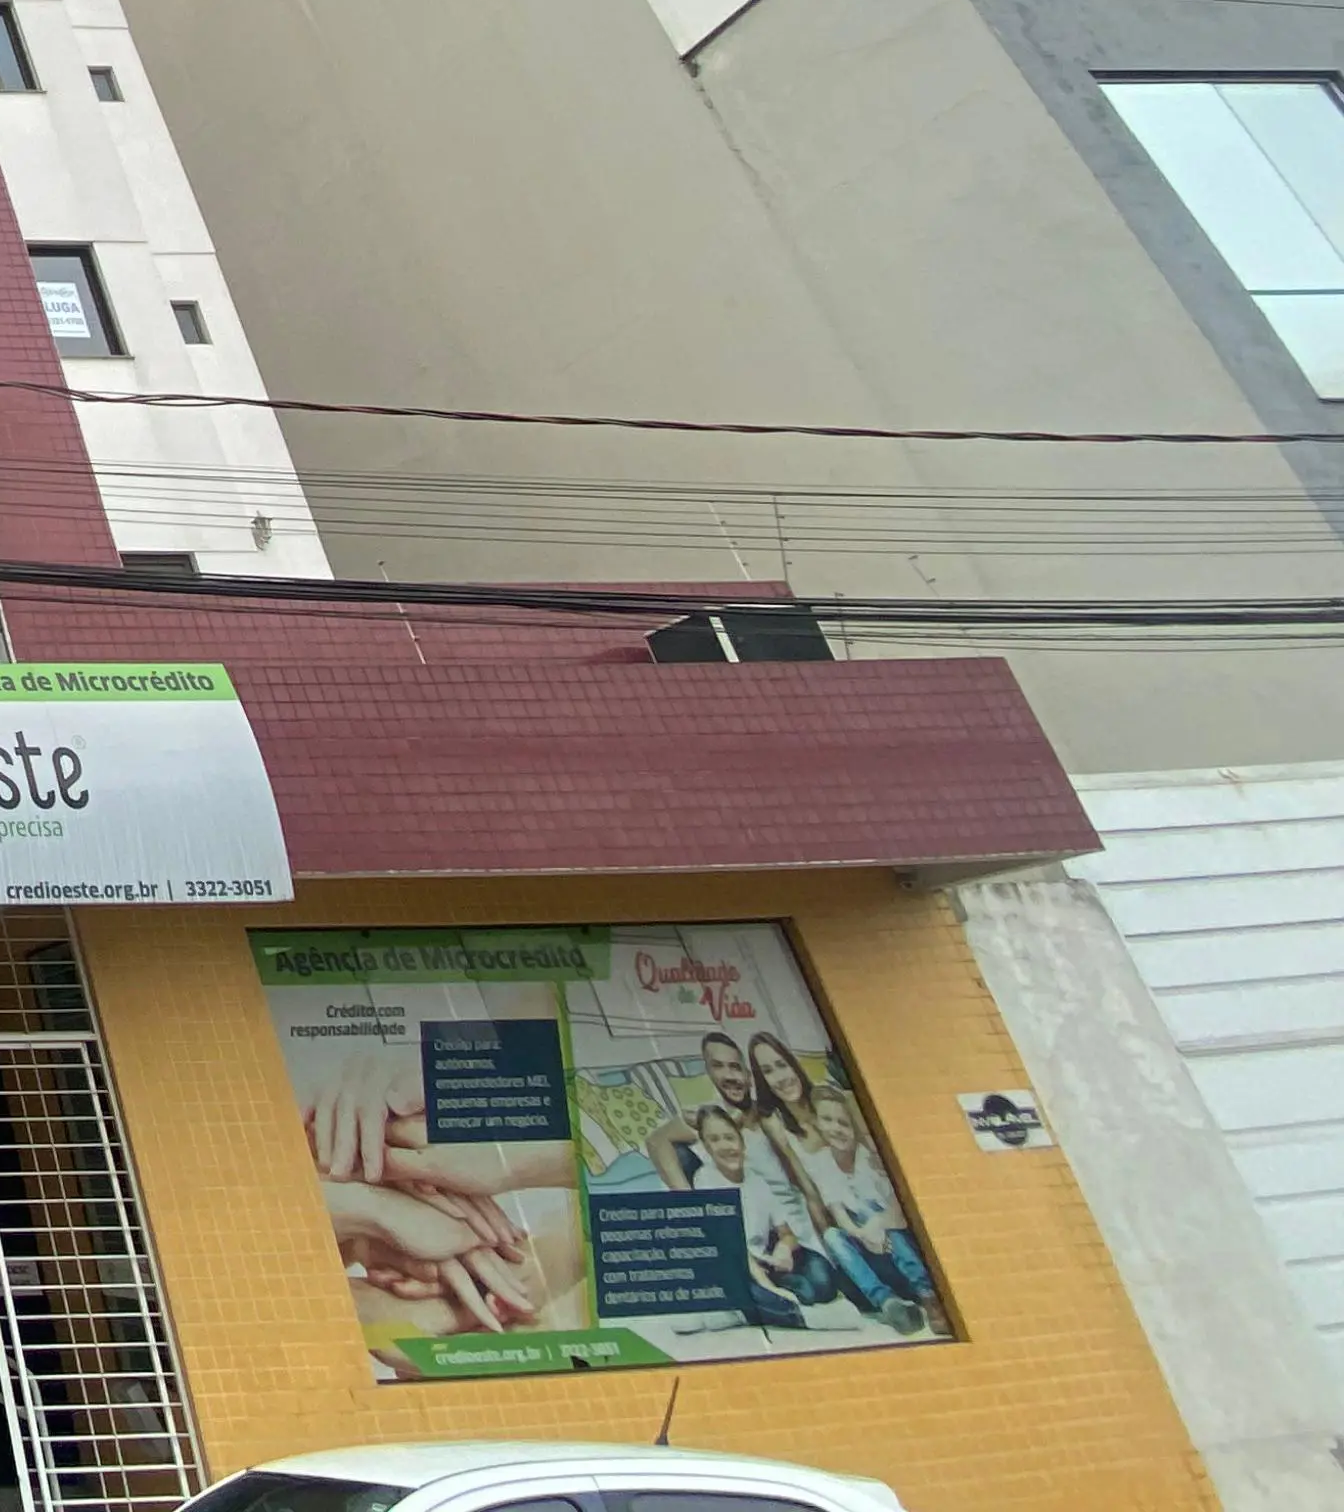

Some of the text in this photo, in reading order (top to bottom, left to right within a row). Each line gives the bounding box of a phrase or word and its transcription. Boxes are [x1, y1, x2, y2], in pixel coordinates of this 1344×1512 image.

[45, 301, 80, 314] LUGA
[21, 672, 53, 692] de
[54, 670, 215, 692] Microcrédito
[6, 879, 272, 901] credioeste.org.br 3322-3051
[276, 945, 587, 977] Agência de Microcrédito
[325, 1004, 405, 1019] Crédito com
